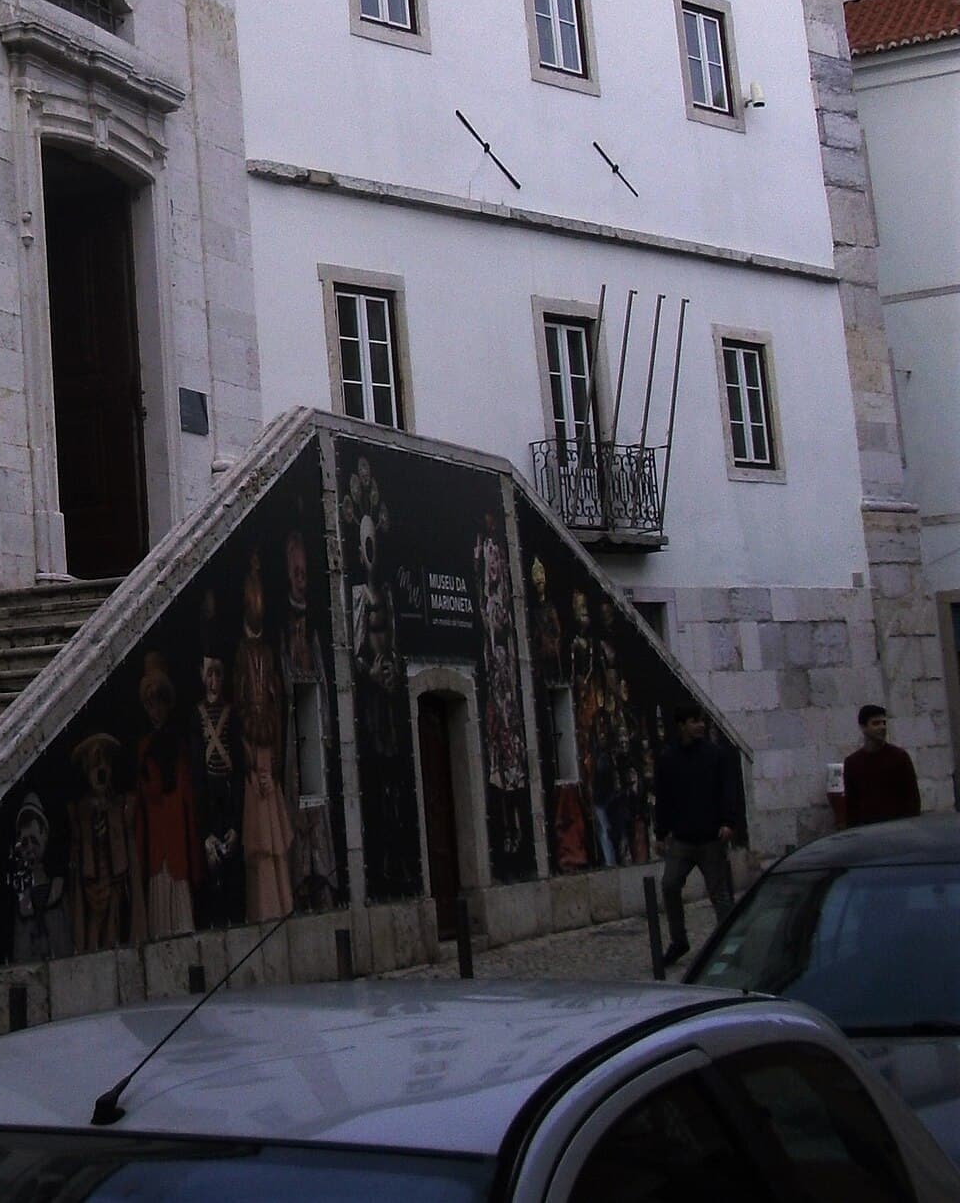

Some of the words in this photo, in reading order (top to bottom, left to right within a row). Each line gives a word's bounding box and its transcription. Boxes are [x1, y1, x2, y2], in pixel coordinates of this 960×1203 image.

[429, 572, 455, 591] MUSEU
[456, 576, 468, 593] DA
[431, 593, 474, 614] MARIONETA
